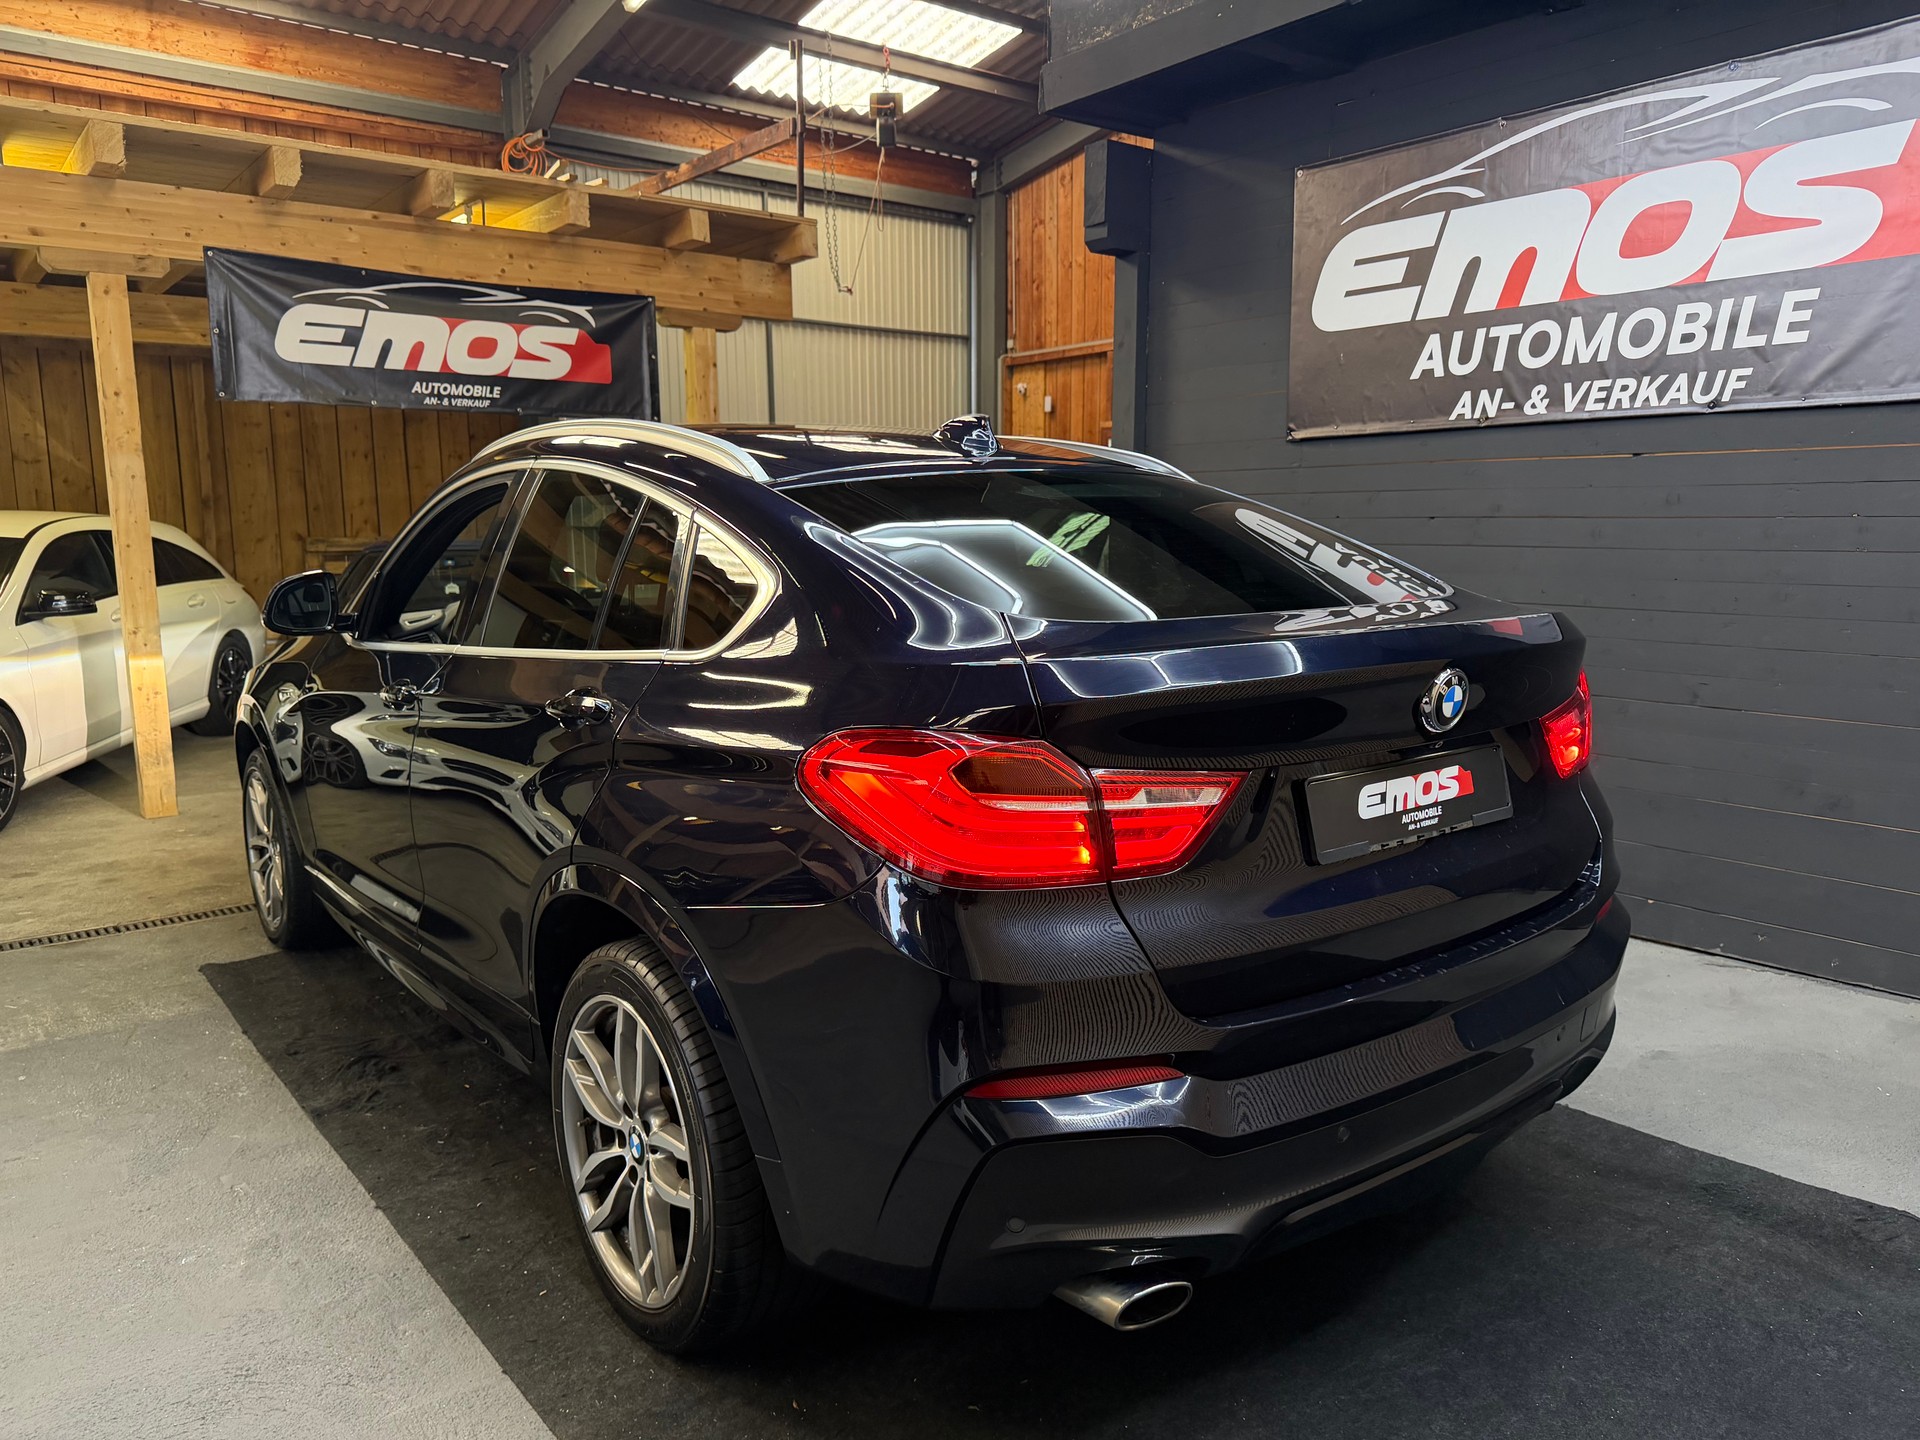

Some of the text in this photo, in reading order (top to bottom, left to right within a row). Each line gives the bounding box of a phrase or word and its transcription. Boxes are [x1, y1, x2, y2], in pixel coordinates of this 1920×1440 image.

[1311, 118, 1918, 332] EMOS
[274, 303, 579, 380] EMOS
[1409, 286, 1821, 380] AUTOMOBILE
[411, 381, 502, 398] AUTOMOBILE
[423, 396, 491, 408] AN- & VERKAUF
[1448, 367, 1753, 421] AN- & VERKAUF
[1358, 765, 1459, 820] EMOS
[1401, 805, 1443, 824] AUTOMOBILE
